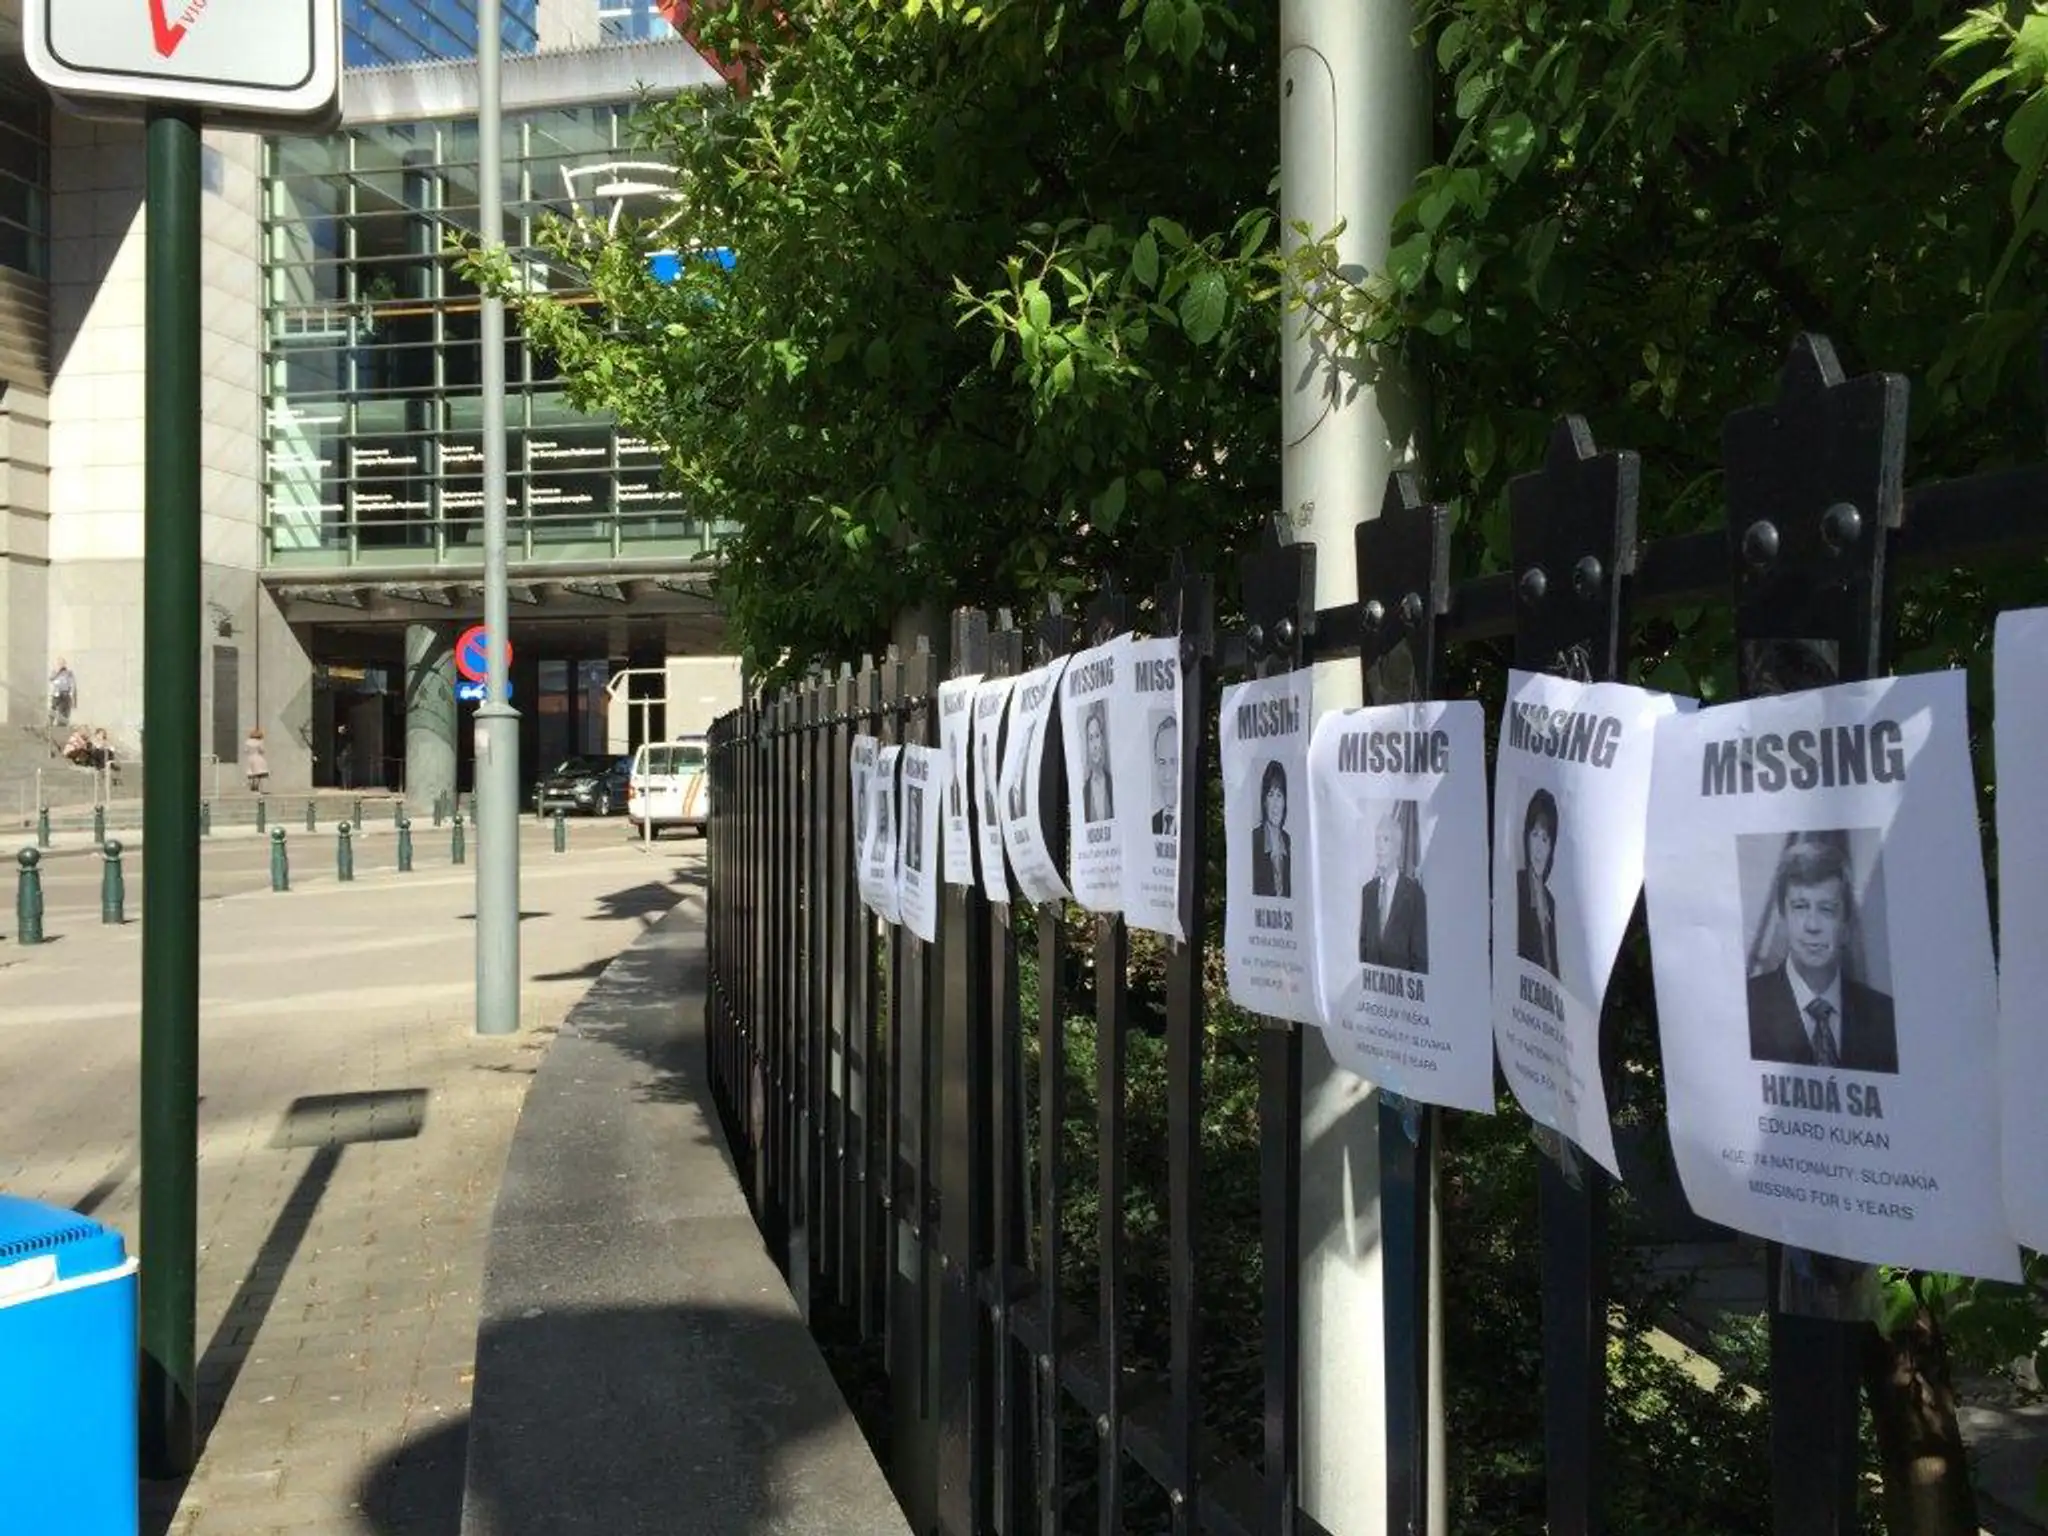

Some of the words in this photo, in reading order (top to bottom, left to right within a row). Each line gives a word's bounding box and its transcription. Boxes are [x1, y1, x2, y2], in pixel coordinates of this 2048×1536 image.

[1338, 730, 1449, 774] MISSING
[1509, 701, 1622, 769] MISSING
[1701, 719, 1905, 797] MISSING
[1845, 1082, 1883, 1120] SA
[1758, 1116, 1825, 1141] EDUARD
[1829, 1125, 1890, 1151] KUKAN
[1749, 1180, 1807, 1203] MISSING
[1809, 1189, 1840, 1209] FOR
[1855, 1199, 1915, 1221] YEARS
[1860, 1169, 1940, 1192] SLOVAKIA
